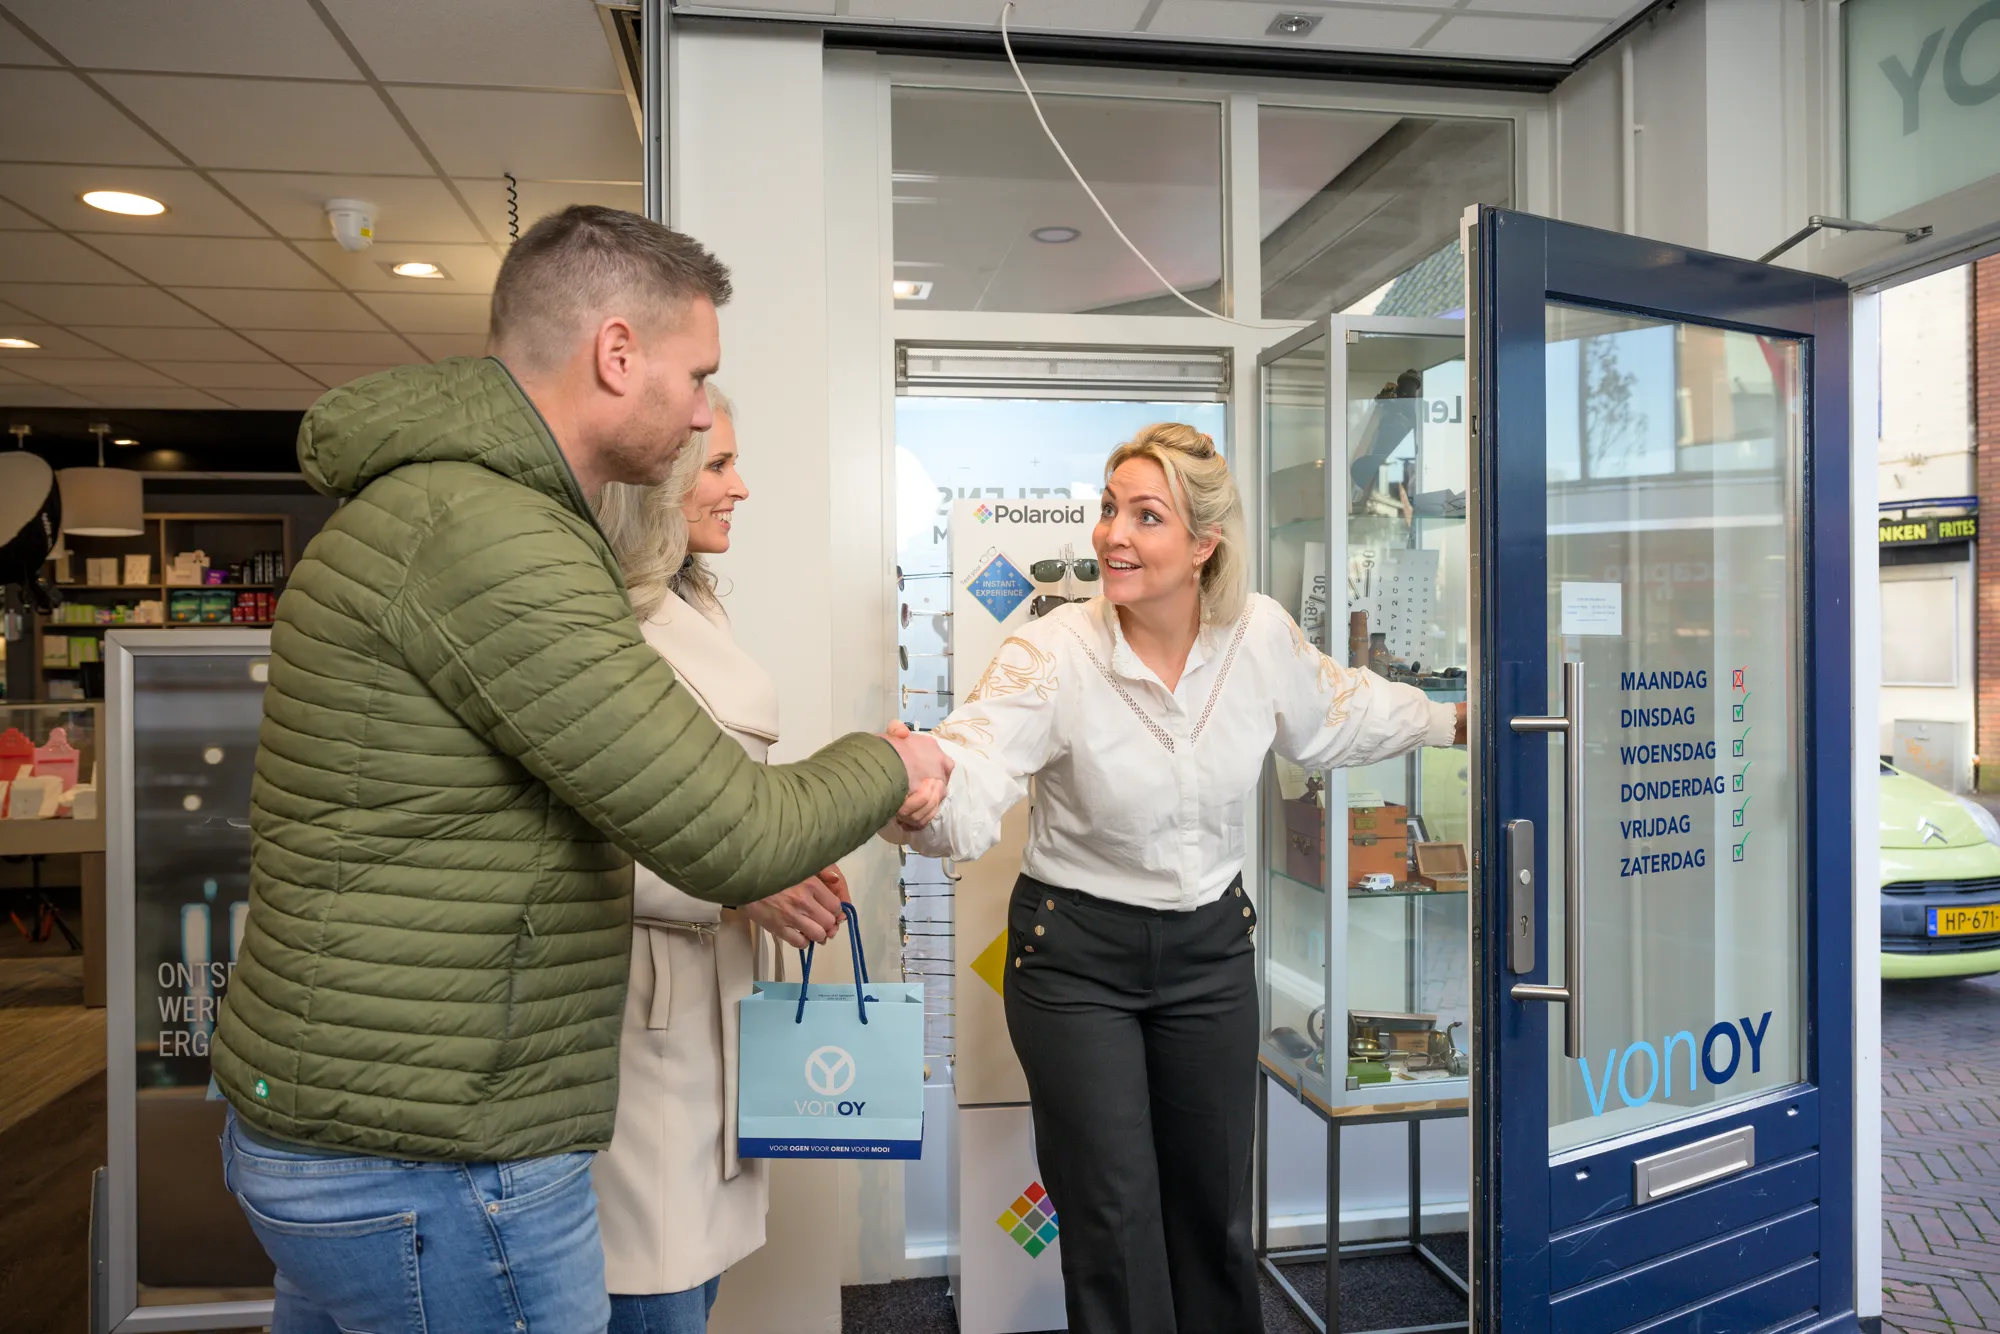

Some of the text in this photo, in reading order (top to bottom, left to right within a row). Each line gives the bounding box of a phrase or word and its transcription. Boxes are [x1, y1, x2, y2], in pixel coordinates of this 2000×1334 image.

[994, 505, 1085, 524] Polaroid
[1938, 519, 1977, 538] FRITES
[975, 589, 1024, 597] EXPERIENCE
[982, 580, 1017, 588] INSTANT
[1621, 670, 1708, 691] MAANDAG
[1621, 706, 1695, 728] DINSDAG
[1620, 741, 1716, 765] WOENSDAG
[1621, 776, 1725, 803] DONDERDAG
[1620, 814, 1691, 839] VRIJDAG
[1620, 848, 1706, 877] ZATERDAG
[159, 1031, 215, 1057] ERG
[1578, 1011, 1773, 1118] vonOY
[794, 1100, 867, 1117] vonOY
